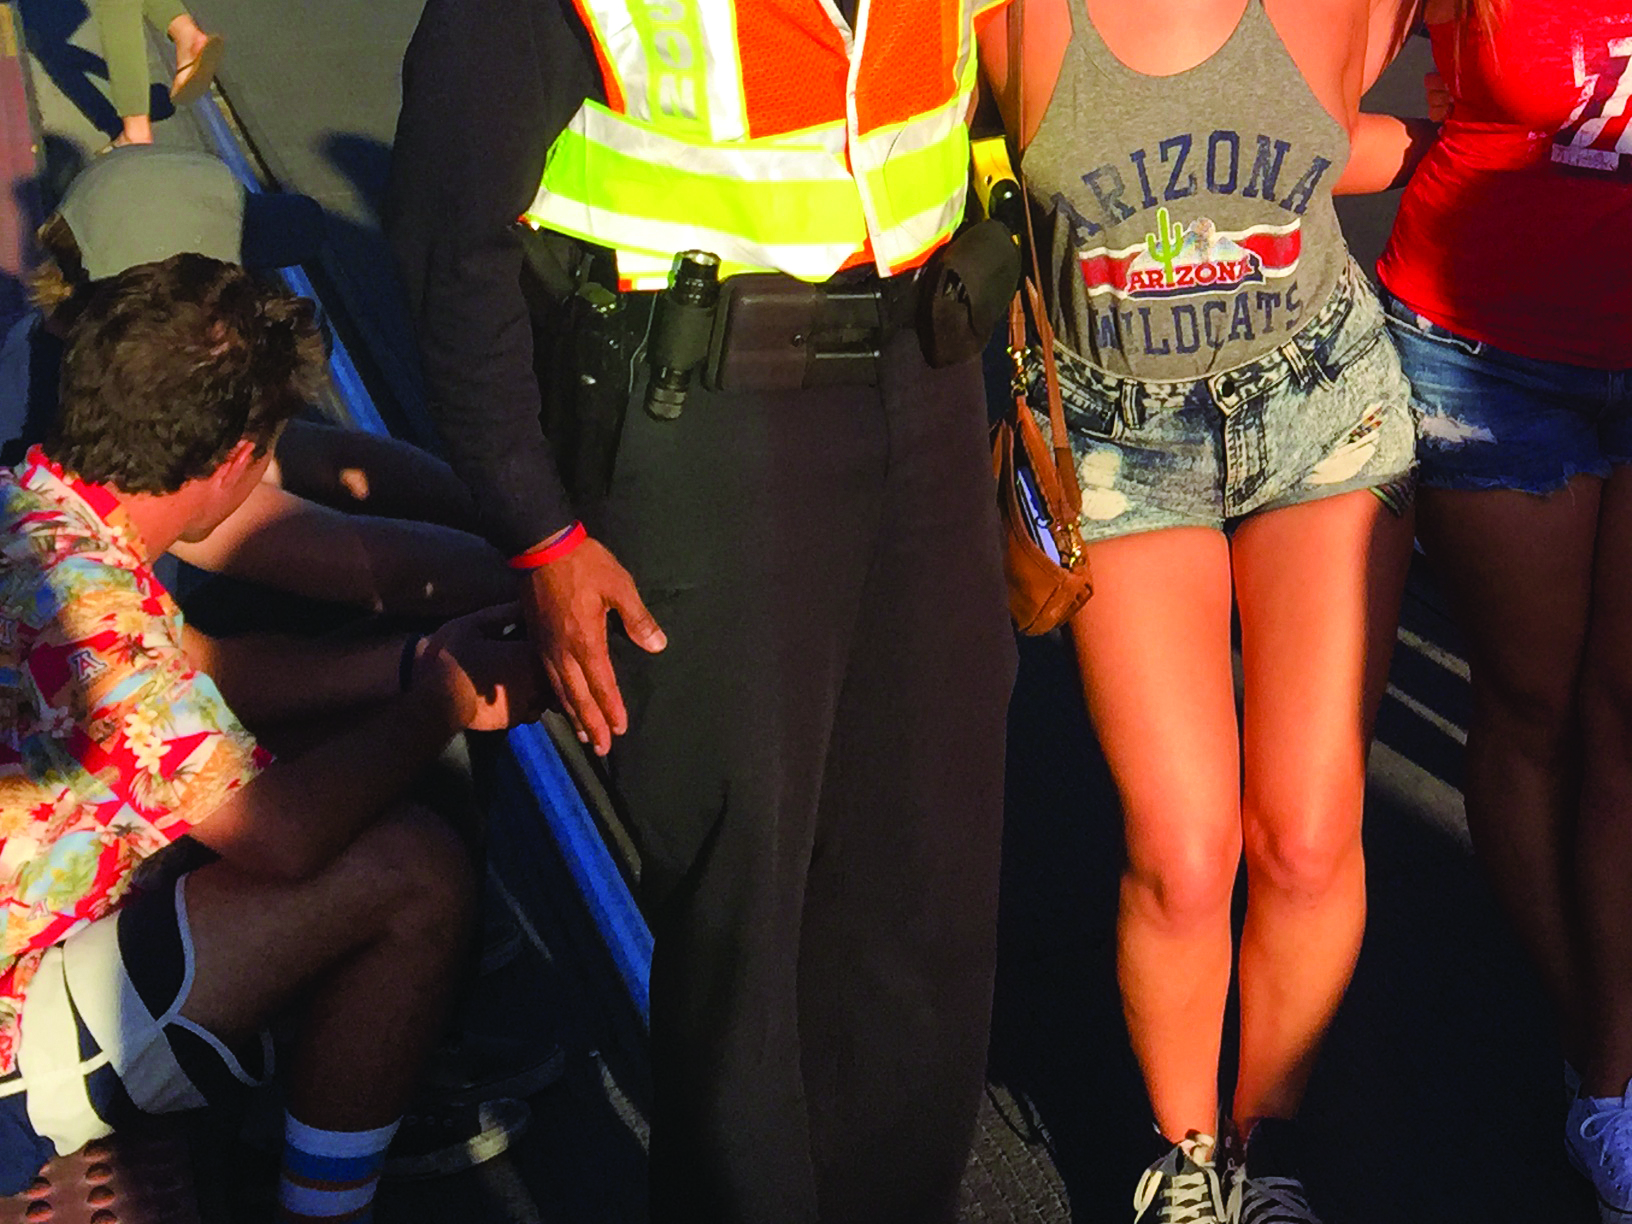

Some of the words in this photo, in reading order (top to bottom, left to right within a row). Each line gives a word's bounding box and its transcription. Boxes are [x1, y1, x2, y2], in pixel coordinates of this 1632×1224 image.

[1051, 130, 1332, 248] ARIZONA
[1126, 254, 1254, 291] ARIZONA
[1095, 281, 1302, 357] WILDCATS
